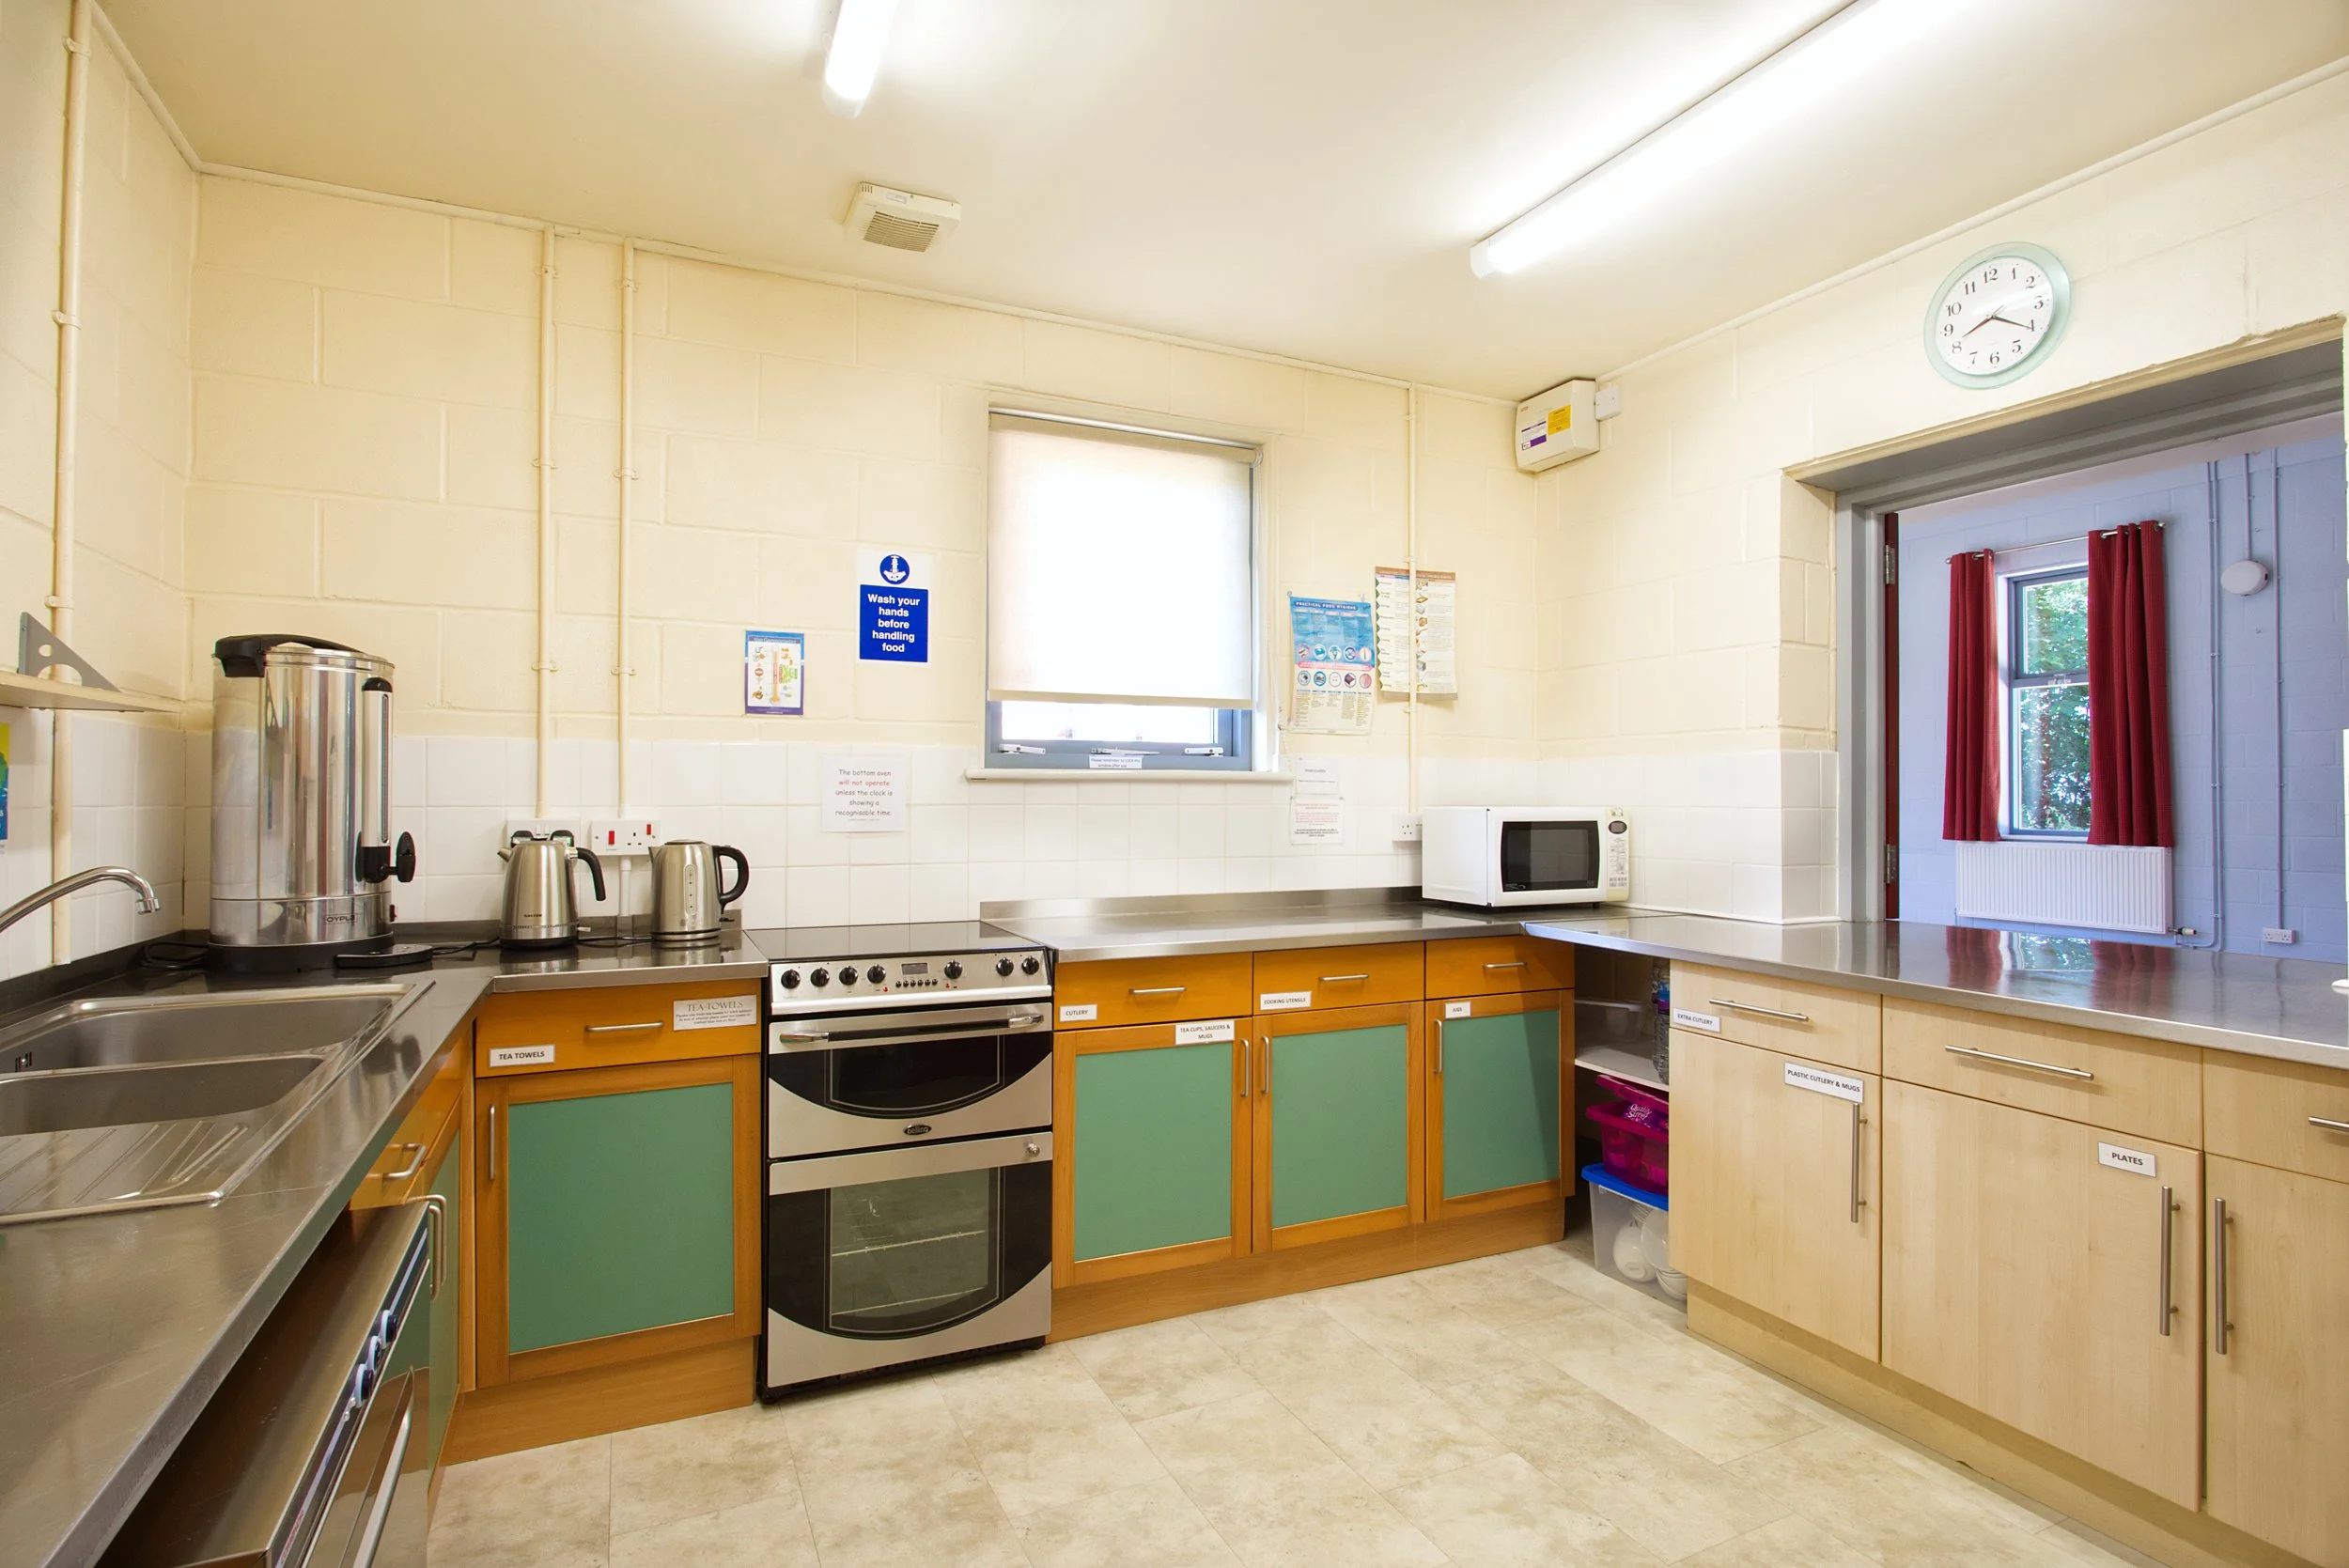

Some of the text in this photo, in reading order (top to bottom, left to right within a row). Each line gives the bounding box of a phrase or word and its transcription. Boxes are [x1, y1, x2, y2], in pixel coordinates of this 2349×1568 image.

[1983, 268, 1998, 284] 12
[2012, 267, 2016, 280] 1
[1964, 281, 1976, 295] 11
[2025, 275, 2036, 289] 2
[1946, 302, 1962, 317] 10
[1943, 323, 1953, 337] 9
[1952, 340, 1962, 354] 8
[2012, 339, 2021, 353] 5
[1969, 350, 1978, 365] 7
[1989, 351, 1999, 365] 6
[867, 593, 920, 607] Wash your
[879, 606, 910, 617] hands
[878, 618, 910, 629] before
[872, 629, 915, 644] handling
[882, 643, 905, 652] food
[835, 809, 875, 817] recognisable
[687, 1000, 744, 1012] TEA TOWELS
[1677, 1013, 1713, 1025] EXTRA CUTLERY
[514, 1050, 545, 1060] TOWELS
[1787, 1069, 1810, 1080] PLASTIC
[1810, 1075, 1835, 1086] CUTLERY
[1841, 1082, 1860, 1093] MUGS
[2111, 1152, 2143, 1166] PLATES
